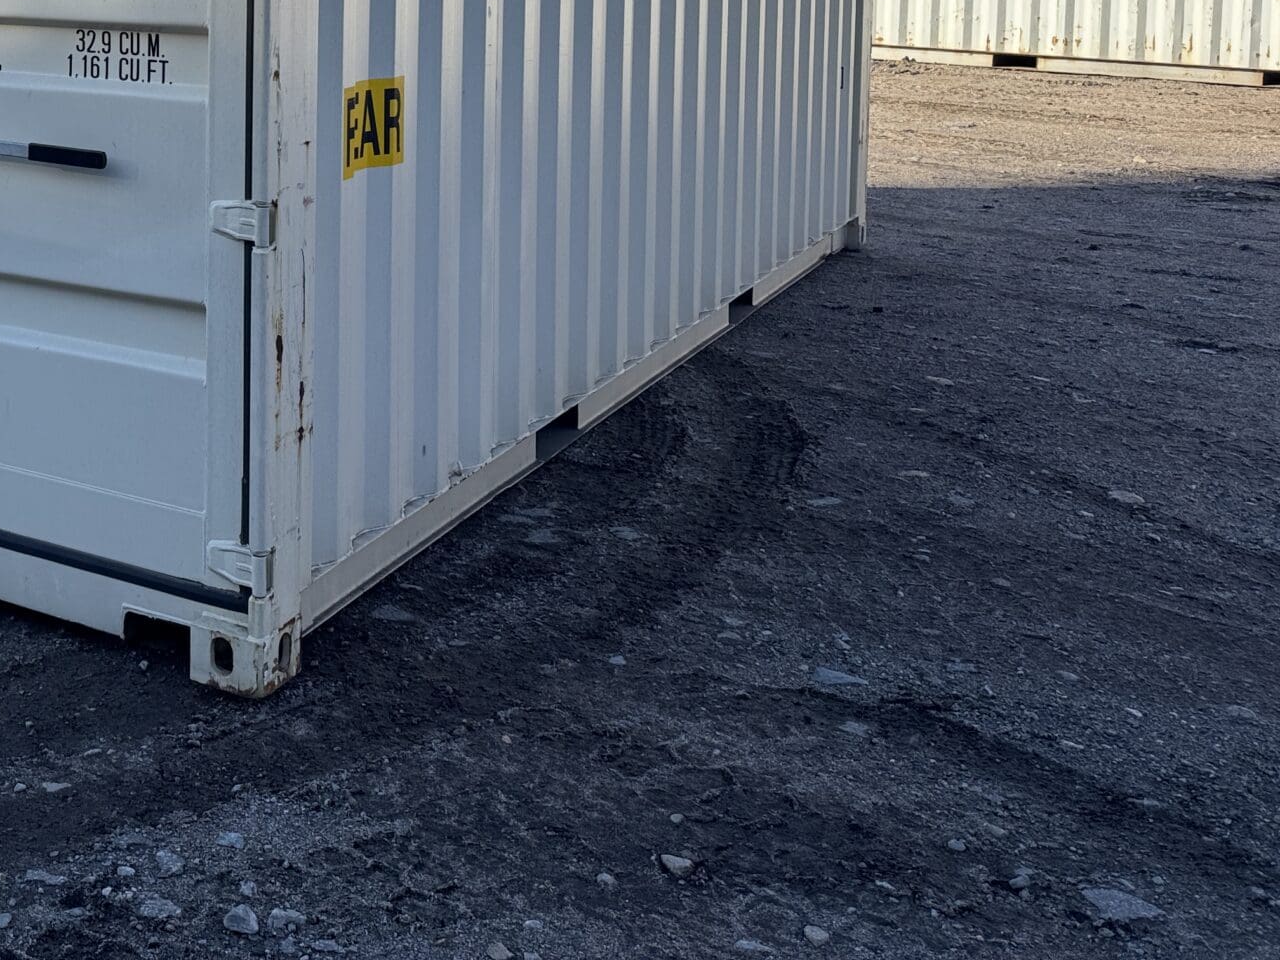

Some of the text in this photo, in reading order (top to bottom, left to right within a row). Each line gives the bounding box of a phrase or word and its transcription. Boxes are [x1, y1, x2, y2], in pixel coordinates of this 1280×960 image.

[75, 29, 111, 54] 32.9
[119, 31, 165, 58] CU.M.
[67, 54, 173, 85] 1,161 CU.FT.
